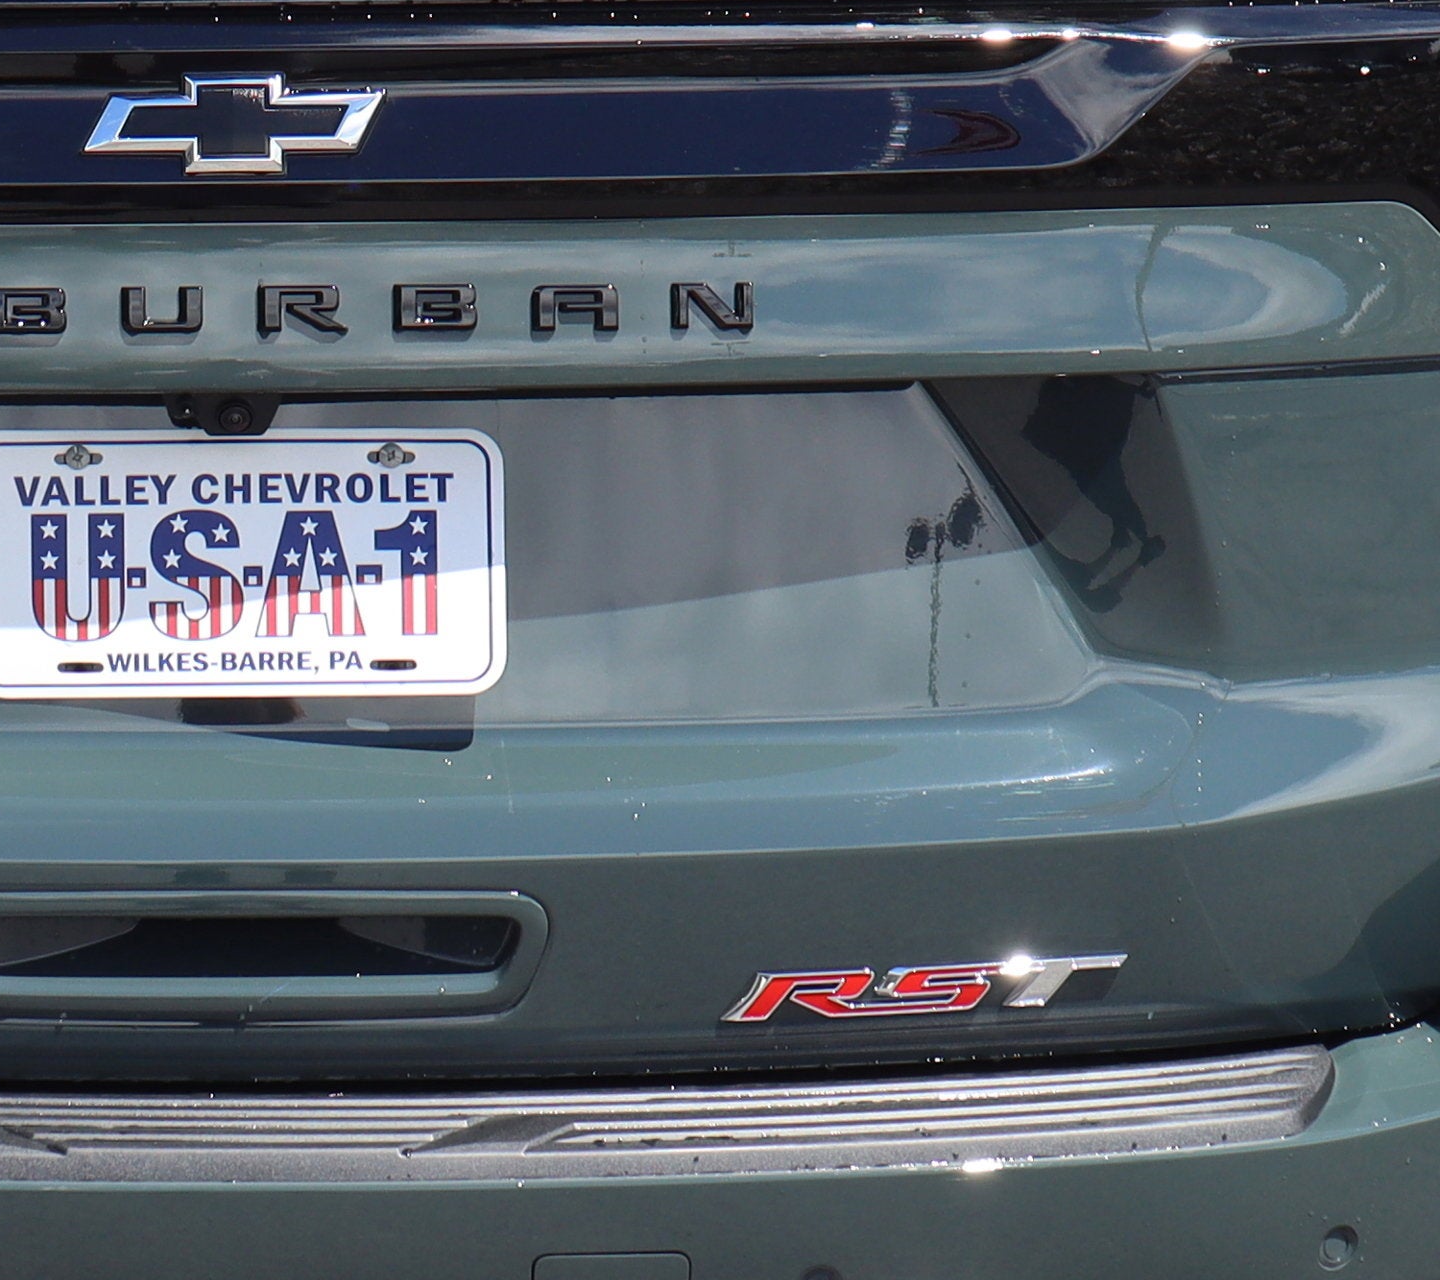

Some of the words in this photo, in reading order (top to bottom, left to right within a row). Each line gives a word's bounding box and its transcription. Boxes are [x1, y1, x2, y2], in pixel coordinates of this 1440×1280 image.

[14, 474, 177, 506] VALLEY
[191, 472, 454, 504] CHEVROLET
[106, 652, 320, 676] WILKES-BARRE,
[329, 651, 364, 671] PA
[720, 953, 1128, 1022] RST
